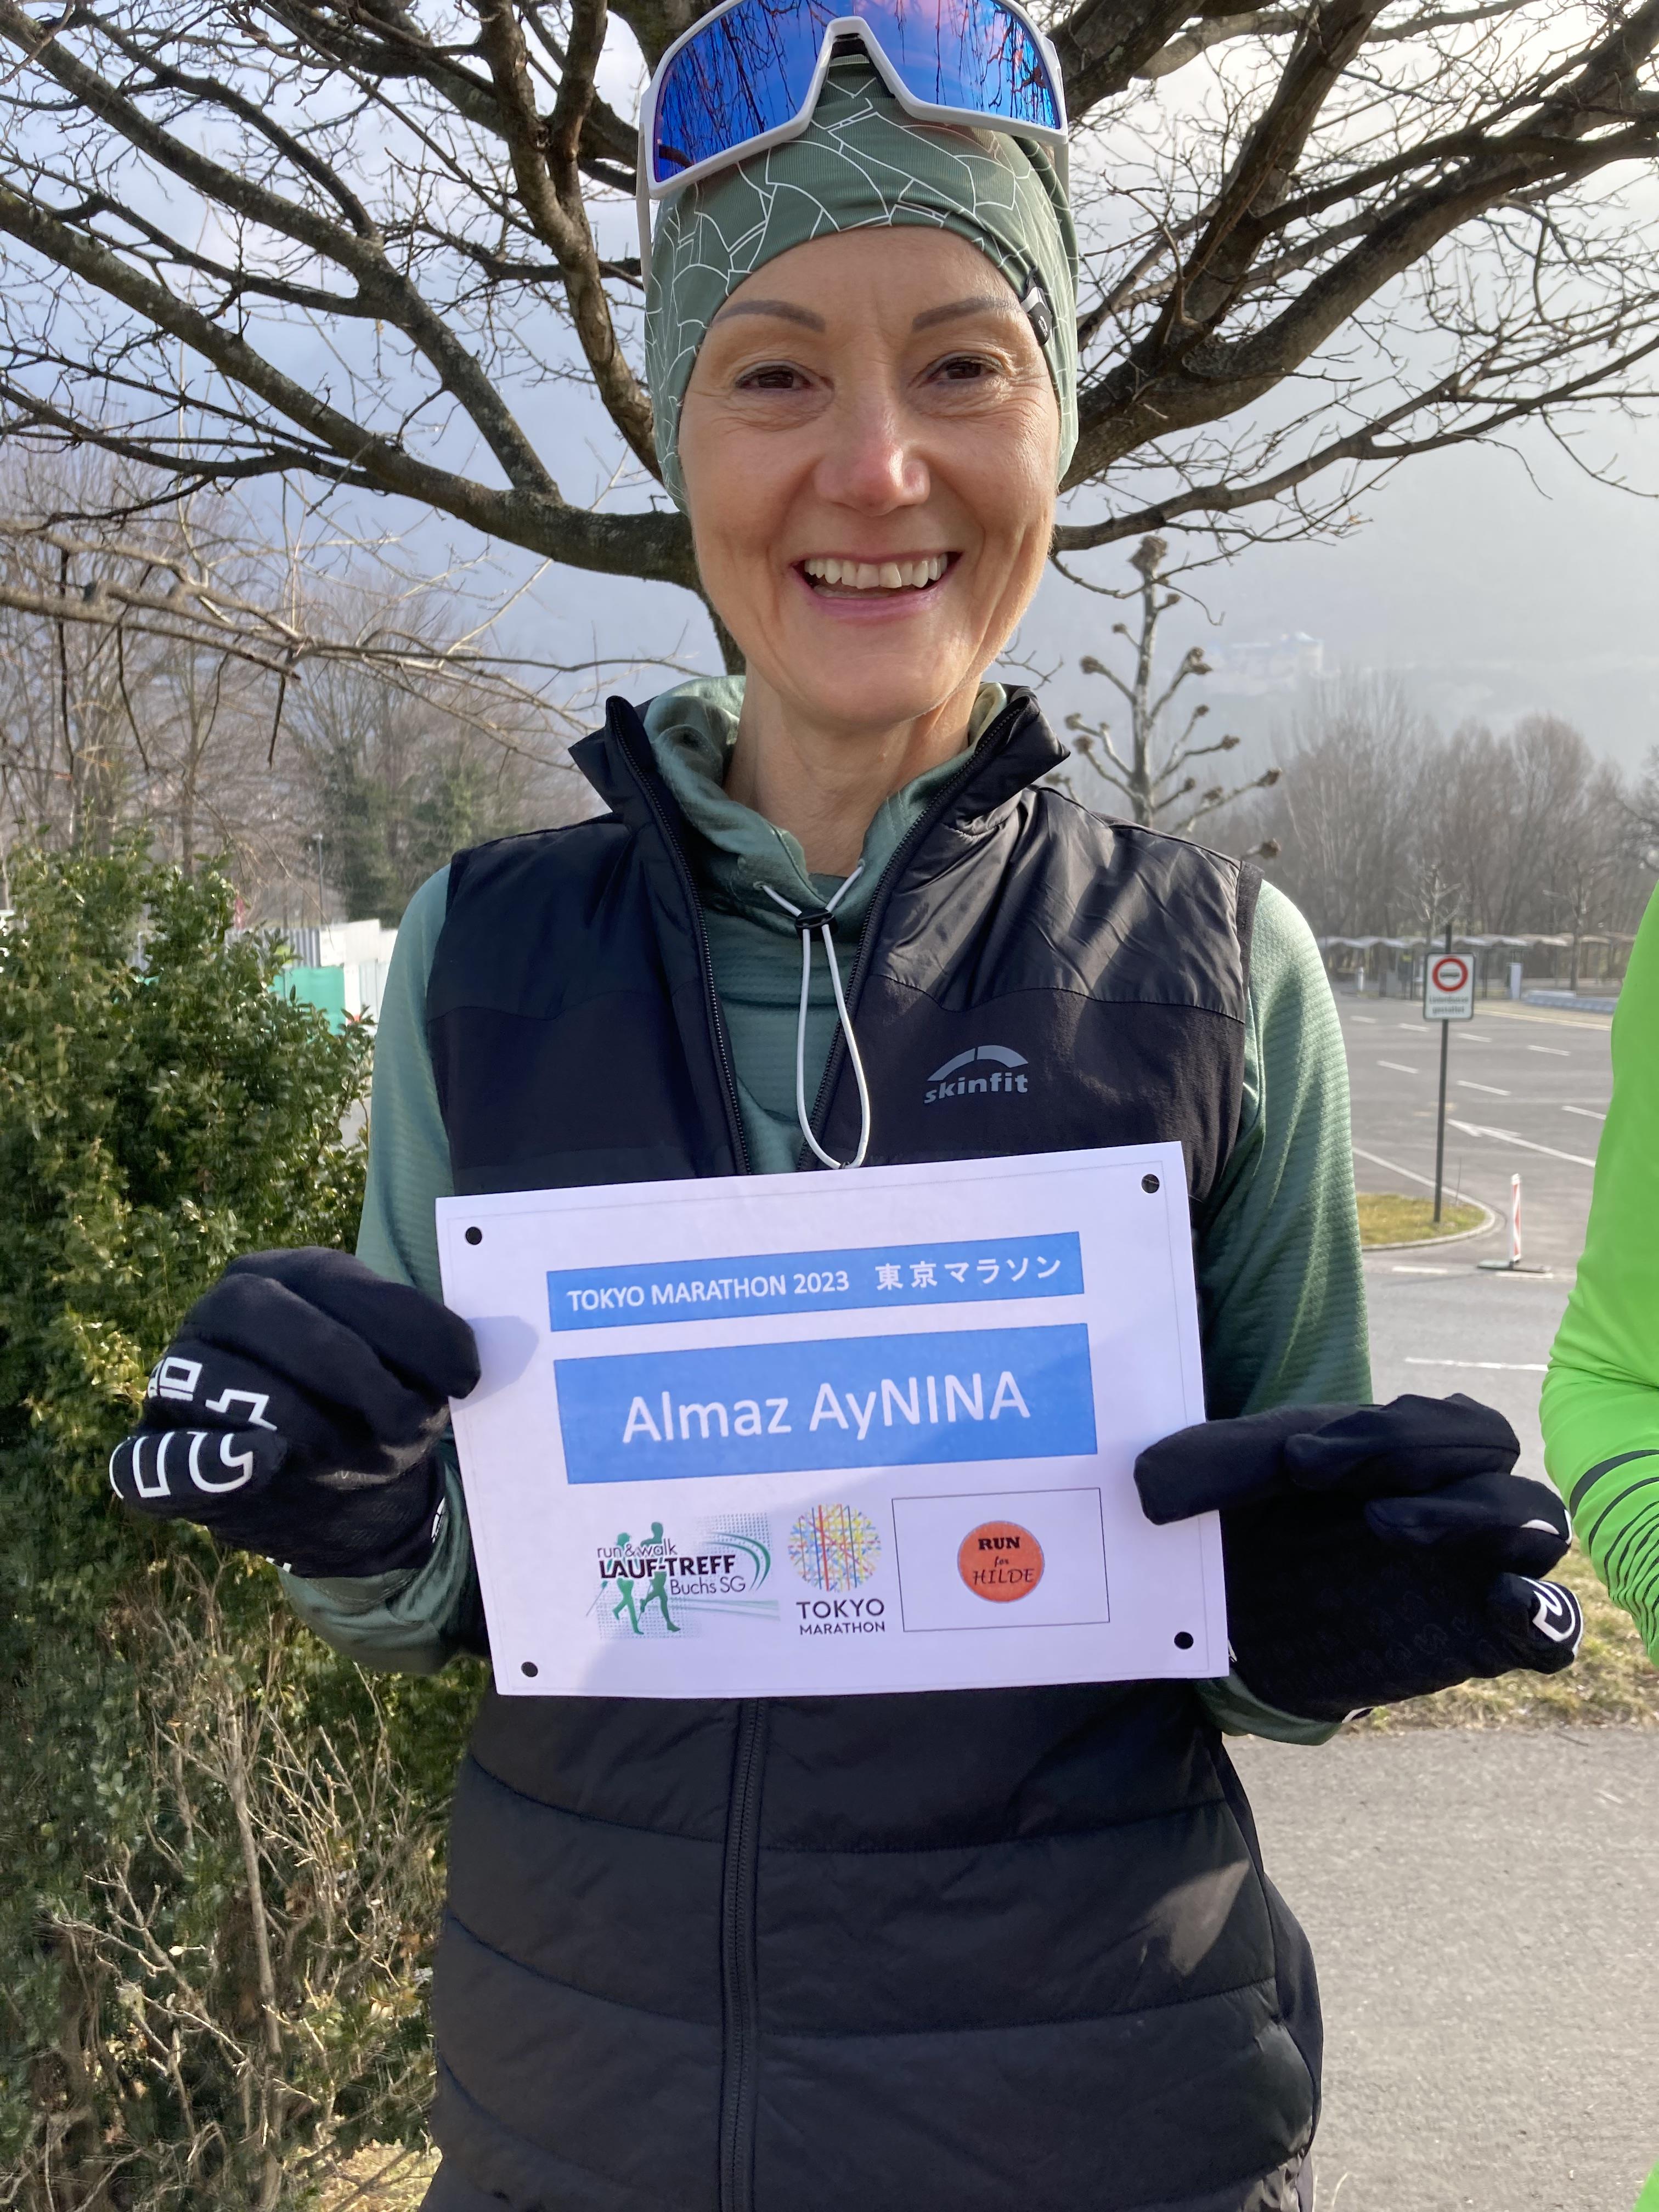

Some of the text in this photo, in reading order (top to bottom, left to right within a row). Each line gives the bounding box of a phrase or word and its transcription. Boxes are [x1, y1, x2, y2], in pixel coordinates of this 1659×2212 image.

[924, 1073, 1029, 1104] skinfit
[567, 1256, 1061, 1312] TOKYO MARATHON 2023 東京マラソン
[622, 1371, 1031, 1443] Almaz AyNINA
[978, 1536, 1020, 1550] RUN
[599, 1554, 736, 1579] LAUF-TREFF
[994, 1556, 1009, 1567] for
[670, 1576, 746, 1595] Buchs SG
[973, 1568, 1035, 1585] HILDE
[796, 1598, 885, 1620] TOKYO
[799, 1621, 885, 1636] MARATHON
